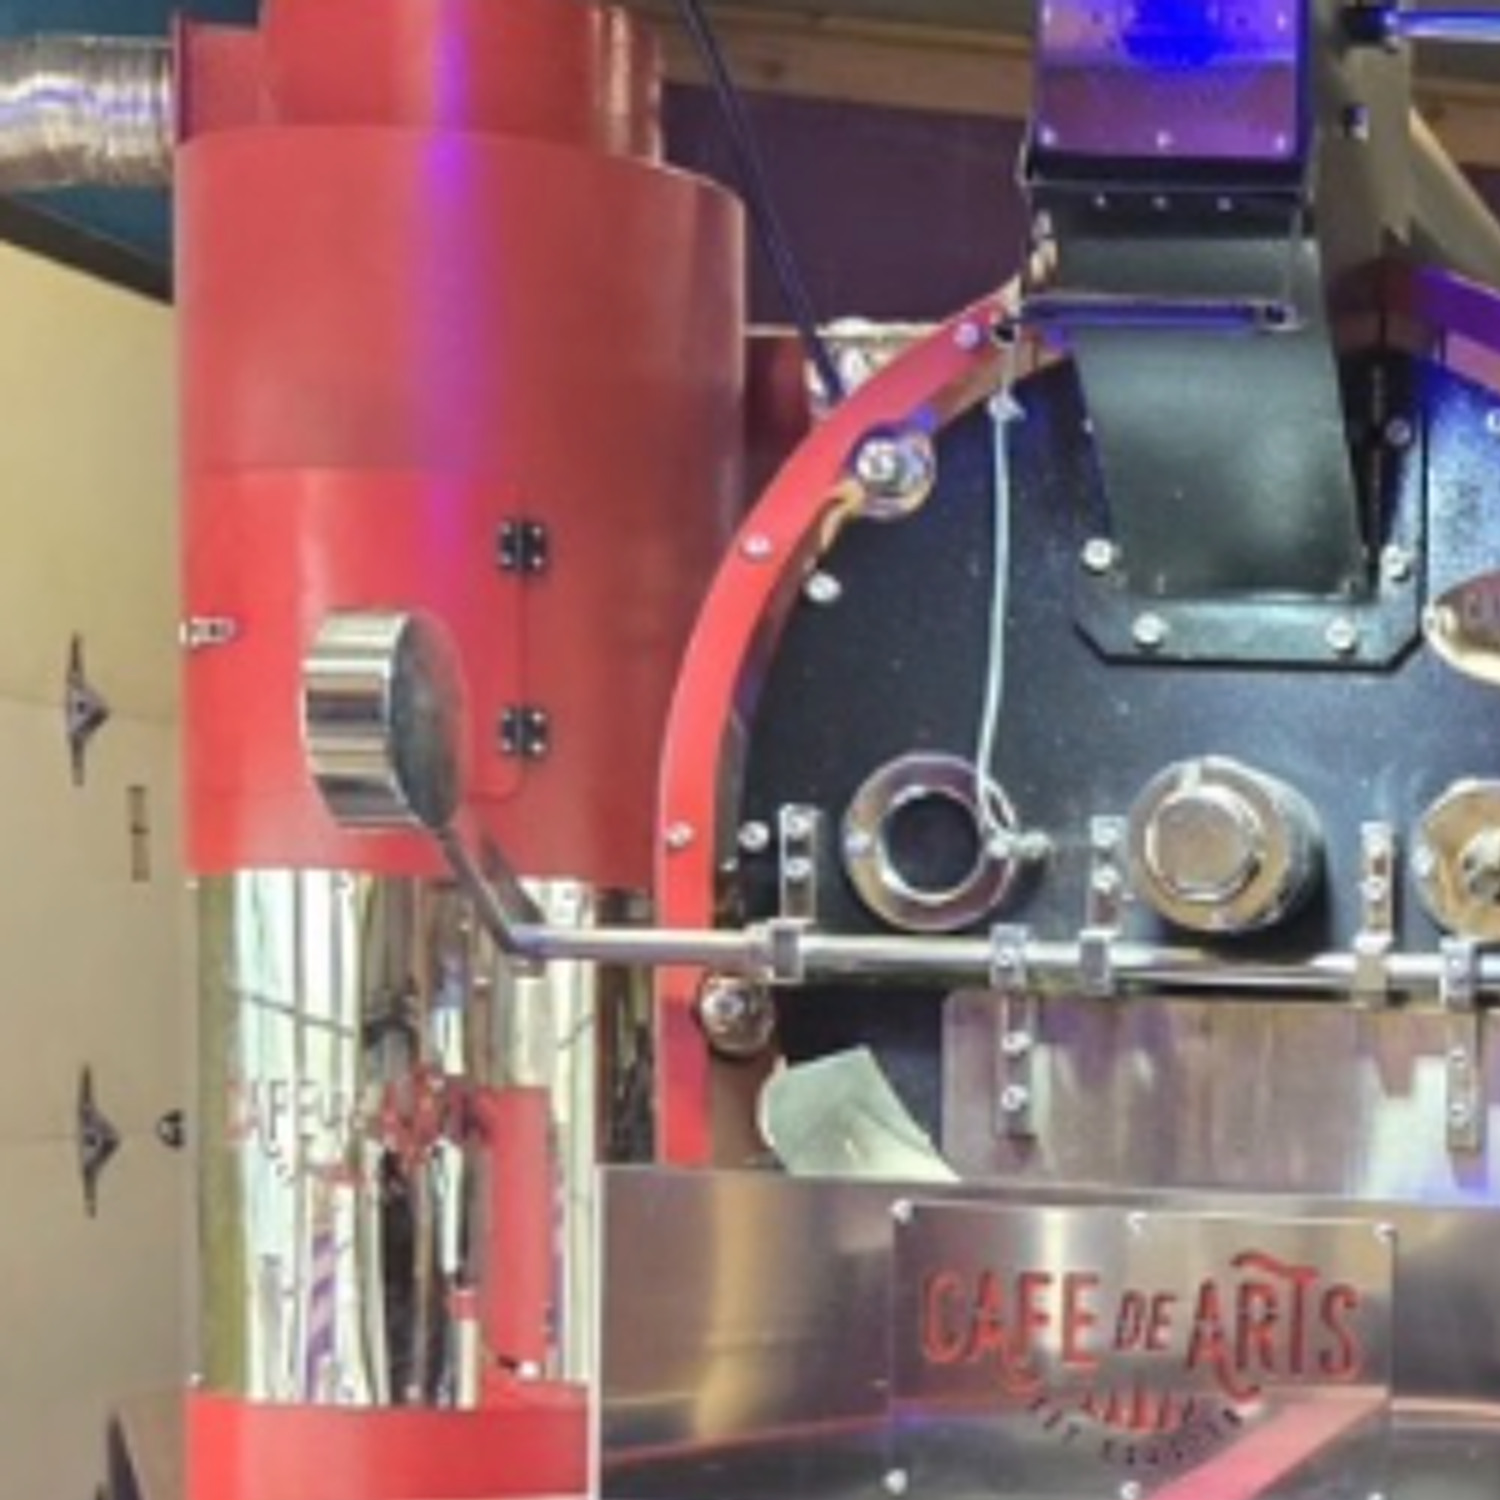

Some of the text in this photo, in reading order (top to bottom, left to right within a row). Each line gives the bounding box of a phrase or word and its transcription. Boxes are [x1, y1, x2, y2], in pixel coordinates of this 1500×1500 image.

[920, 1248, 1362, 1404] CAFE DE ARTS
